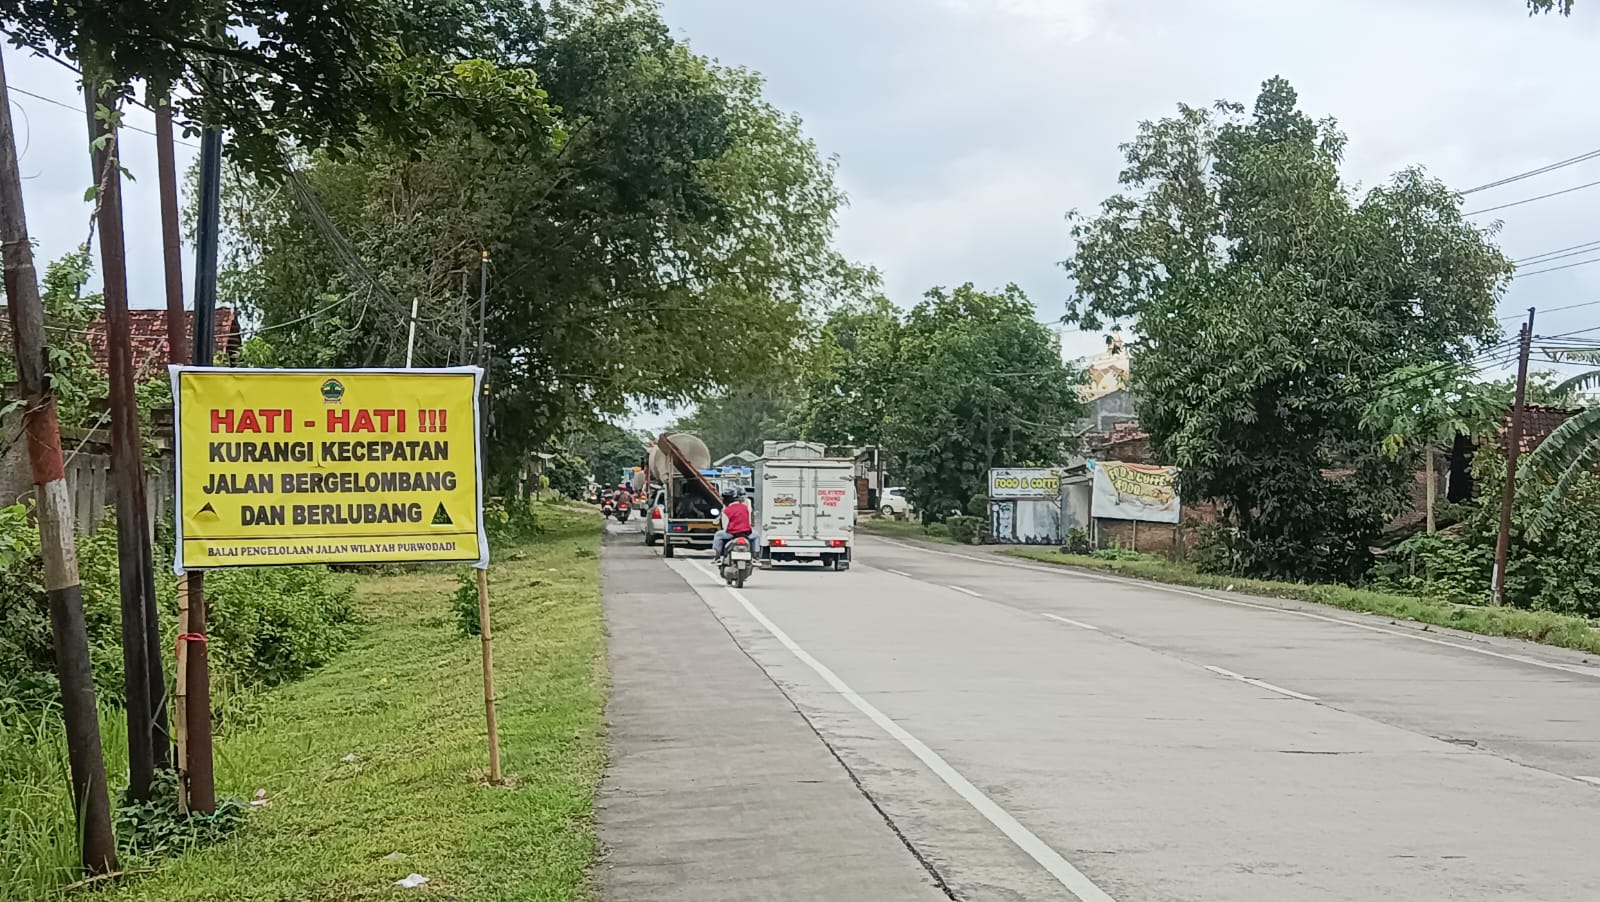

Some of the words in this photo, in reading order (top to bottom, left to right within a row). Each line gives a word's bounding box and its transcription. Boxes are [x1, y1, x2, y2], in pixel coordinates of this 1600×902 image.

[210, 409, 292, 433] HATI
[327, 409, 406, 432] HATI
[418, 409, 447, 432] !!!
[209, 442, 313, 462] KURANGI
[321, 441, 448, 461] KECEPATAN
[202, 473, 274, 494] JALAN
[281, 471, 457, 493] BERGELOMBANG
[995, 478, 1019, 489] FOOD
[241, 505, 285, 526] DAN
[292, 503, 422, 525] BERLUBANG
[208, 547, 239, 557] BALAI
[241, 545, 313, 556] PENGELOLAAN
[316, 545, 348, 554] JALAN
[350, 543, 395, 554] WILAYAH
[397, 542, 456, 552] PURWODADI
